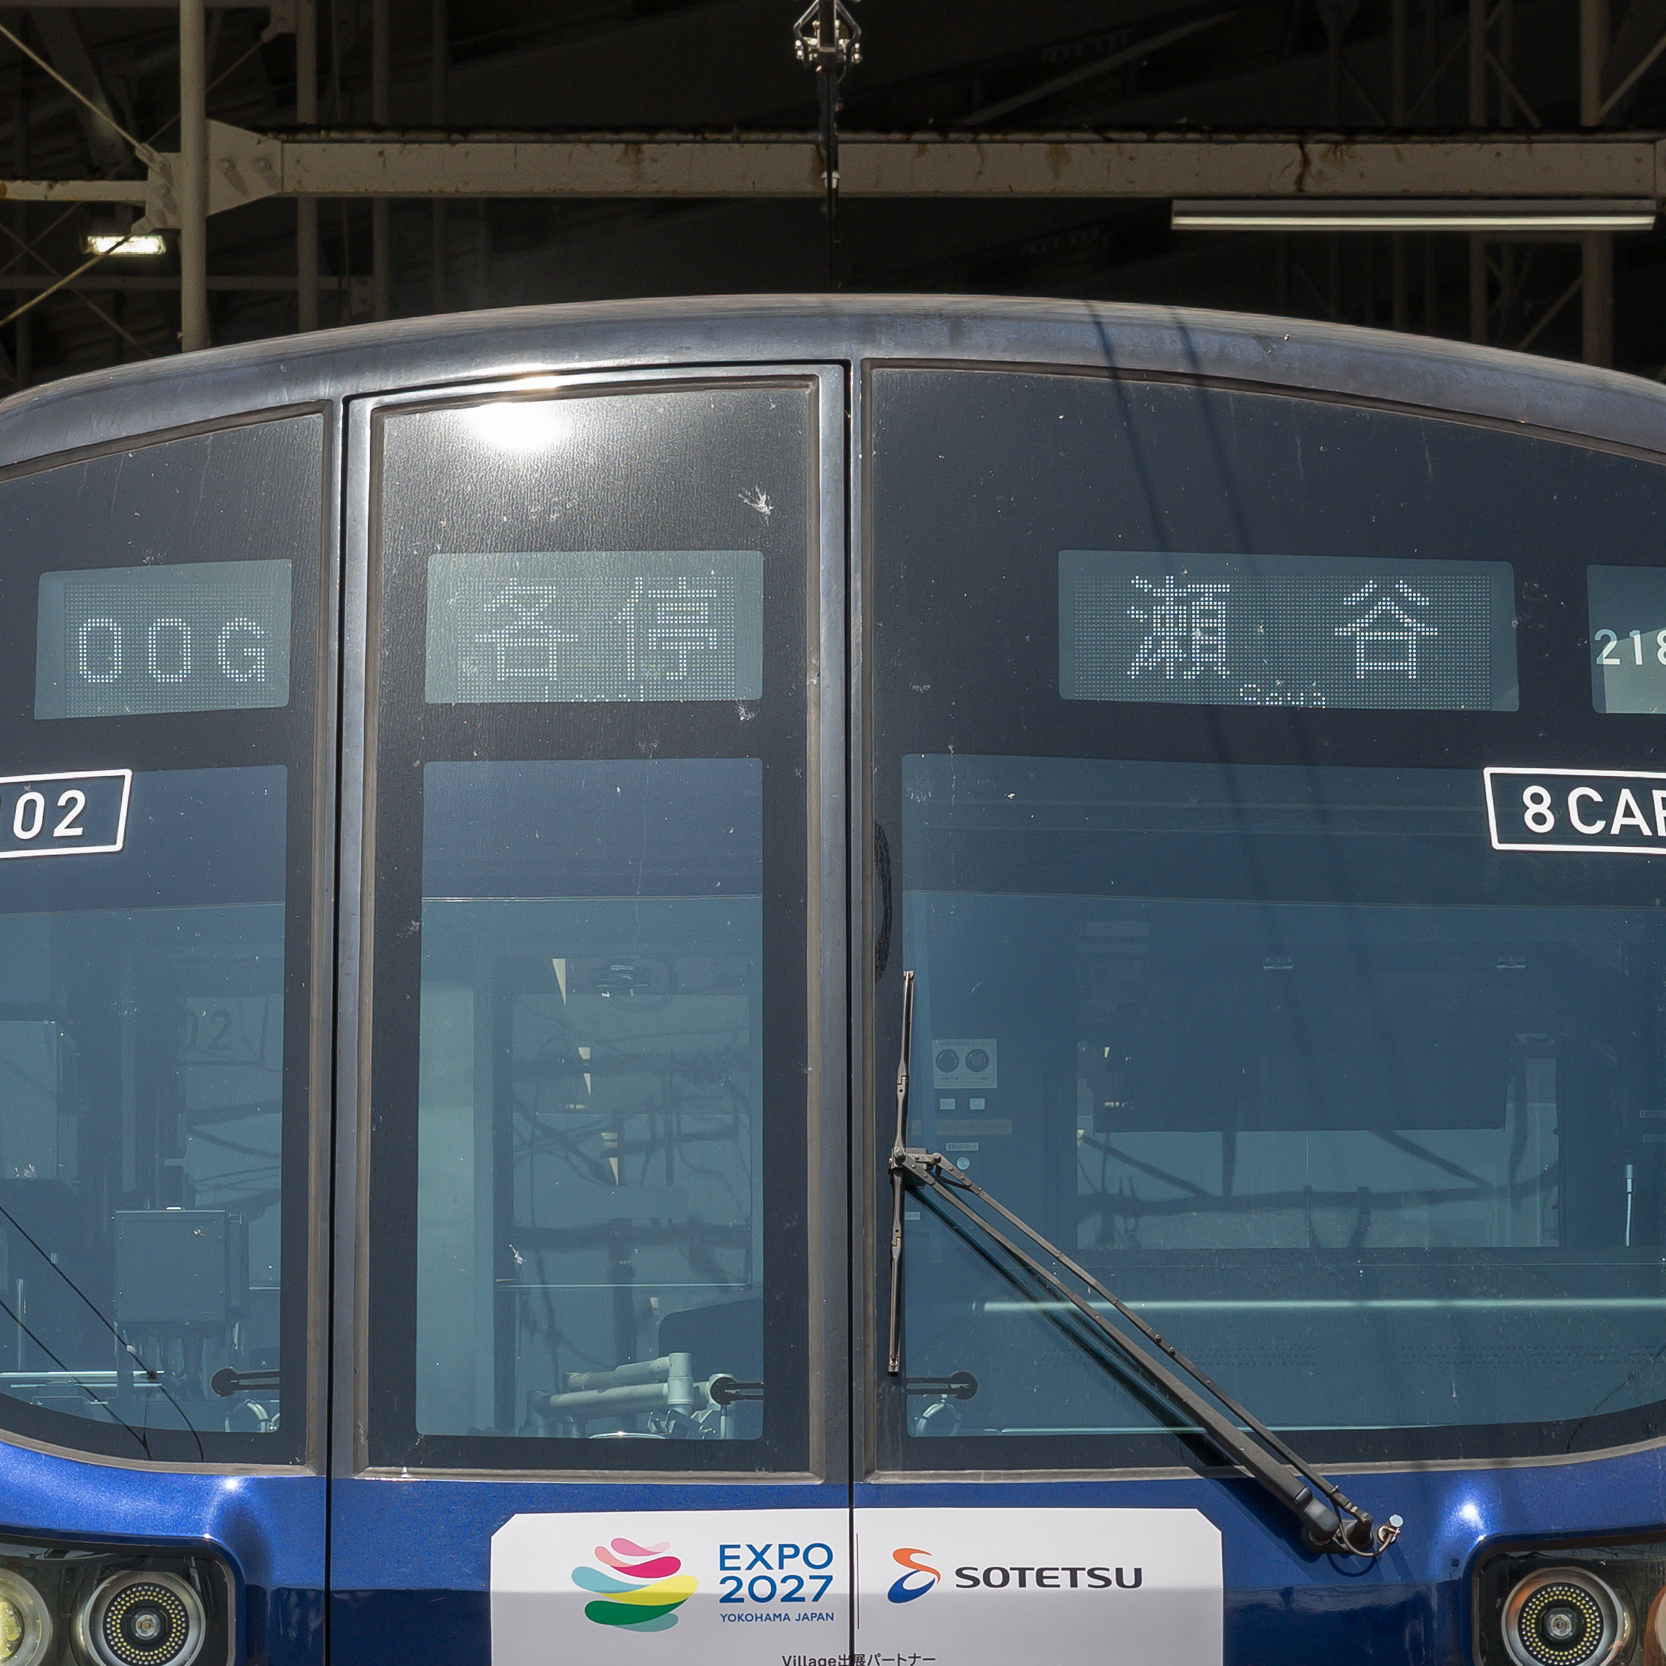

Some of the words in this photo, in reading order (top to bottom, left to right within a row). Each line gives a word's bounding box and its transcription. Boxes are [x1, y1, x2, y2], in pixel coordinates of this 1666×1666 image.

[474, 576, 718, 682] 各停
[1127, 574, 1439, 681] 瀬谷
[718, 1542, 835, 1572] EXPO
[718, 1575, 835, 1605] 2027
[954, 1565, 1144, 1590] SOTETSU
[719, 1612, 792, 1623] YOKOHAMA
[794, 1612, 835, 1622] JAPAN
